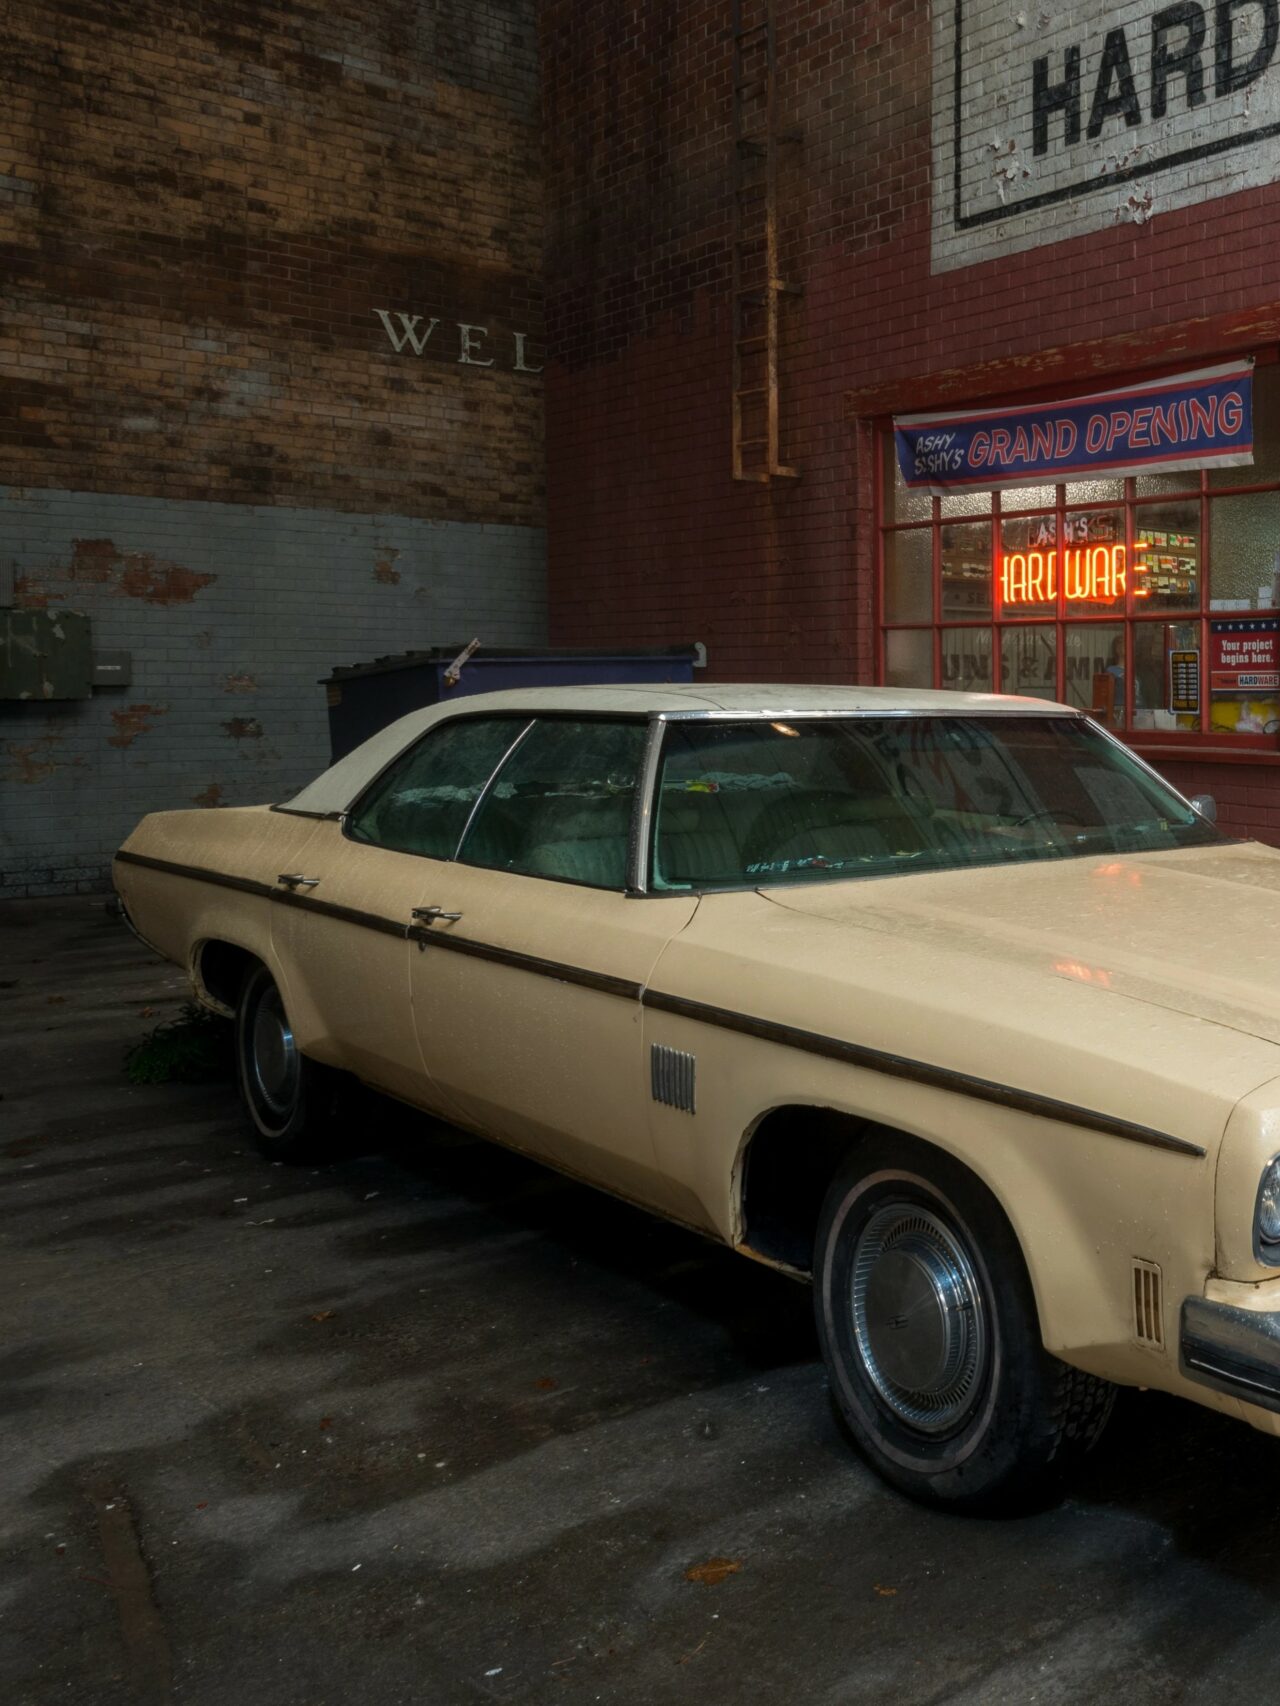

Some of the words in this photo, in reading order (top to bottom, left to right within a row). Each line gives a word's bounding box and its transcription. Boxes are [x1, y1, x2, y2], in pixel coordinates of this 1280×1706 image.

[372, 308, 544, 373] WEL
[967, 420, 1078, 468] GRAND
[1085, 391, 1244, 453] OPENING
[915, 432, 957, 454] ASHY
[1036, 516, 1089, 545] ASH'S
[1221, 640, 1240, 651] Your
[1243, 638, 1273, 653] project
[1220, 652, 1249, 666] begins
[1252, 651, 1274, 663] here.
[1239, 675, 1278, 686] HARDWARE
